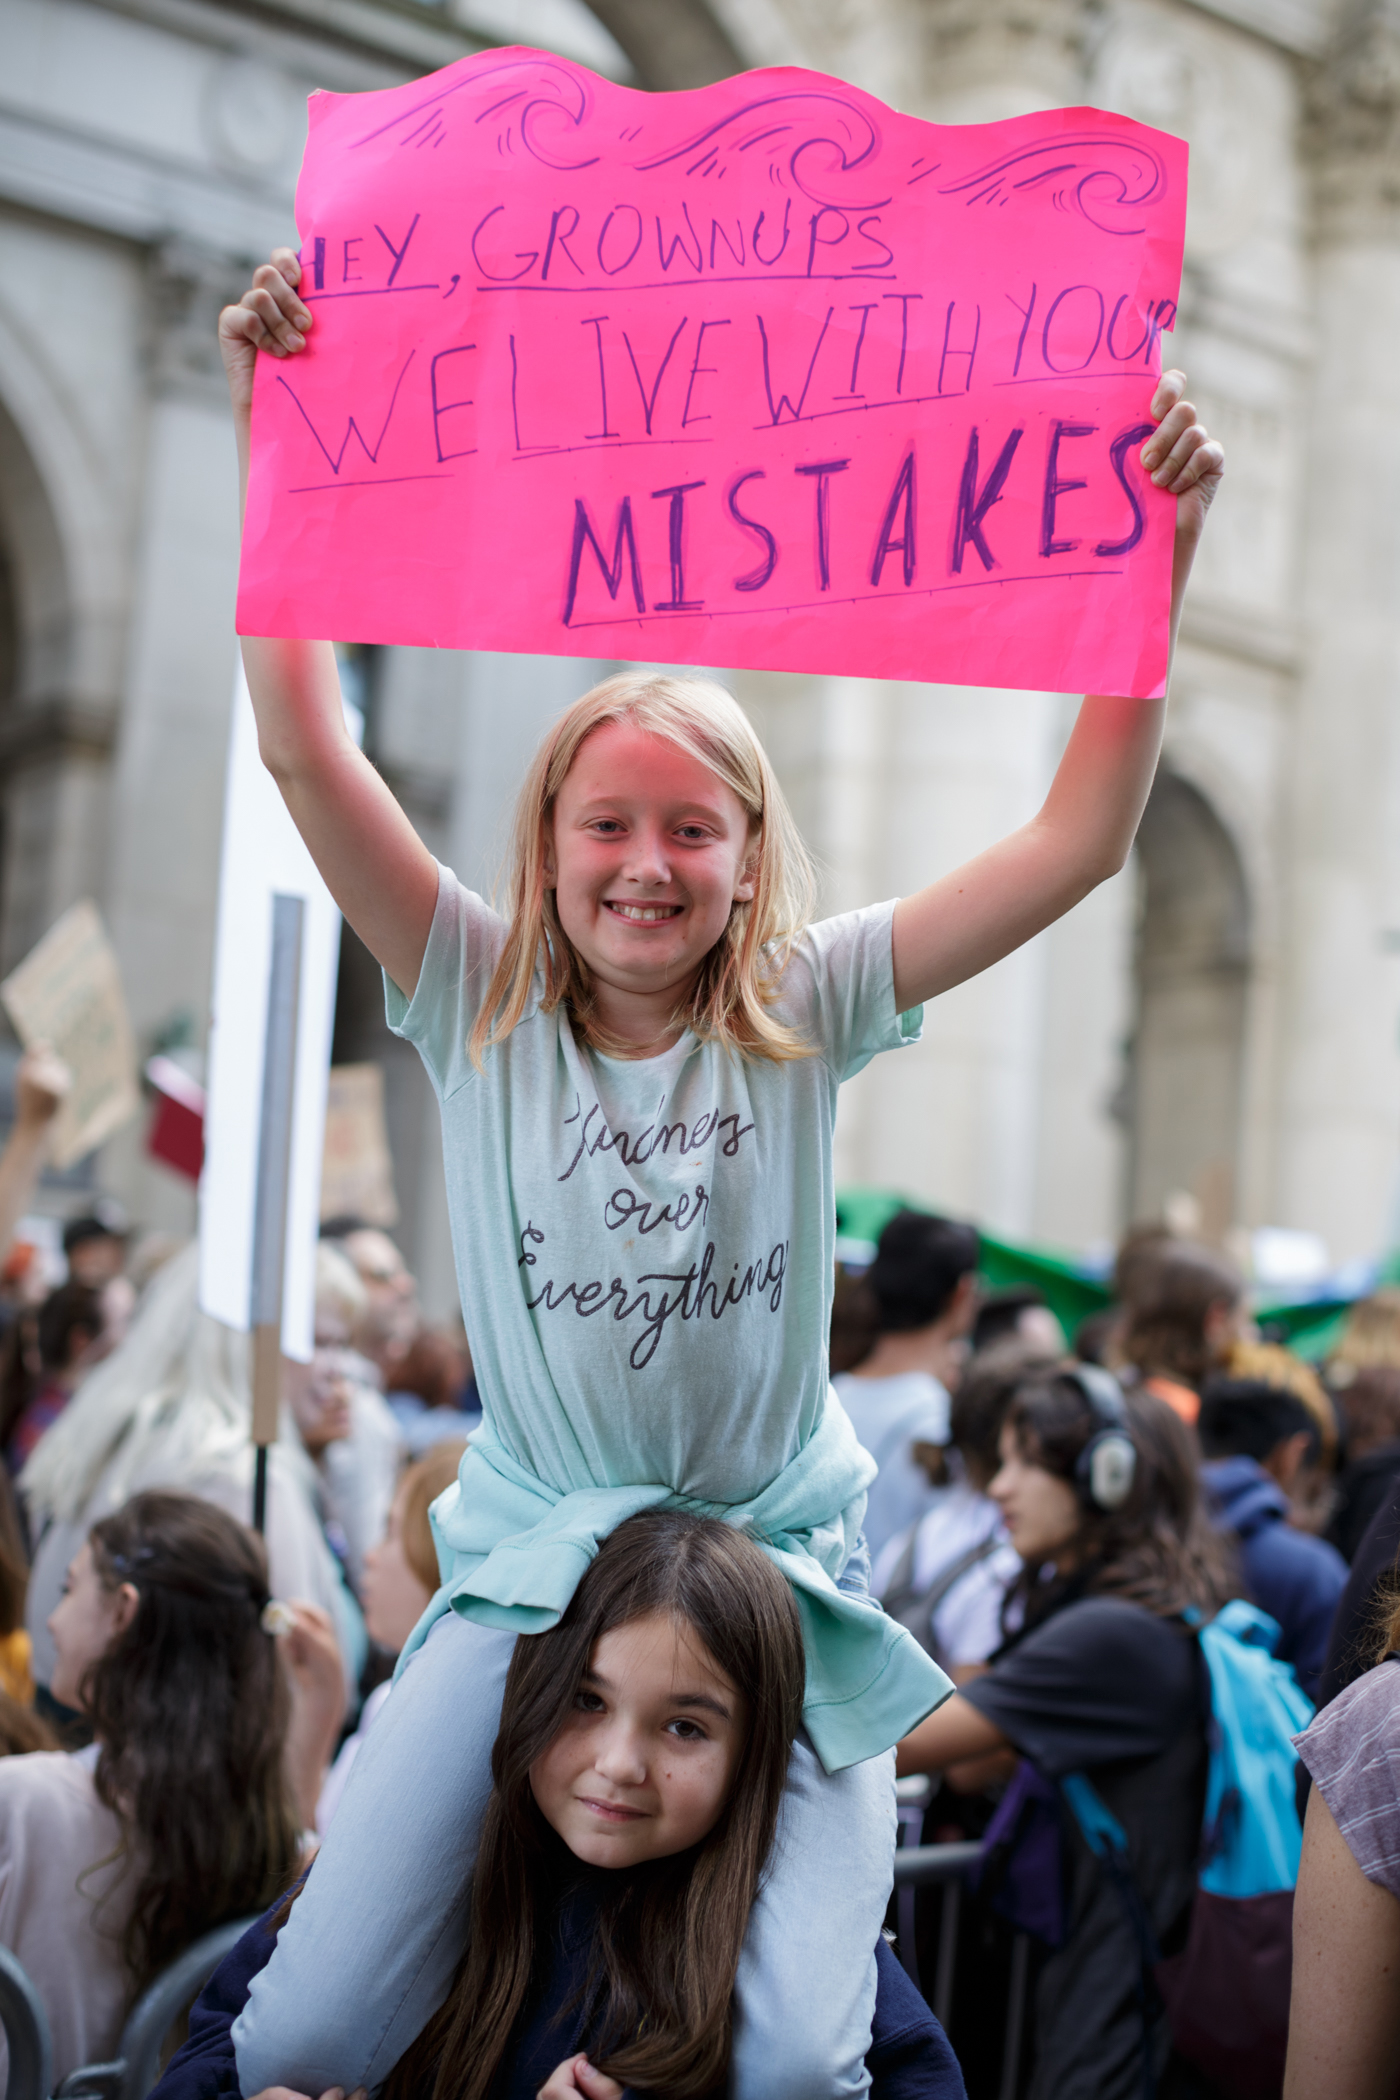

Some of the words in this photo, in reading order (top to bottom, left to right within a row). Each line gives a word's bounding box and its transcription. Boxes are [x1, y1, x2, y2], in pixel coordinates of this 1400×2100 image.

[471, 198, 895, 281] GROWNUPS
[275, 344, 478, 476] WE
[508, 315, 732, 452] LIVE
[756, 293, 981, 427] WITH
[1004, 282, 1178, 378] YOUR
[562, 420, 1158, 627] MISTAKES
[604, 1184, 709, 1235] over
[517, 1219, 790, 1371] Everything
